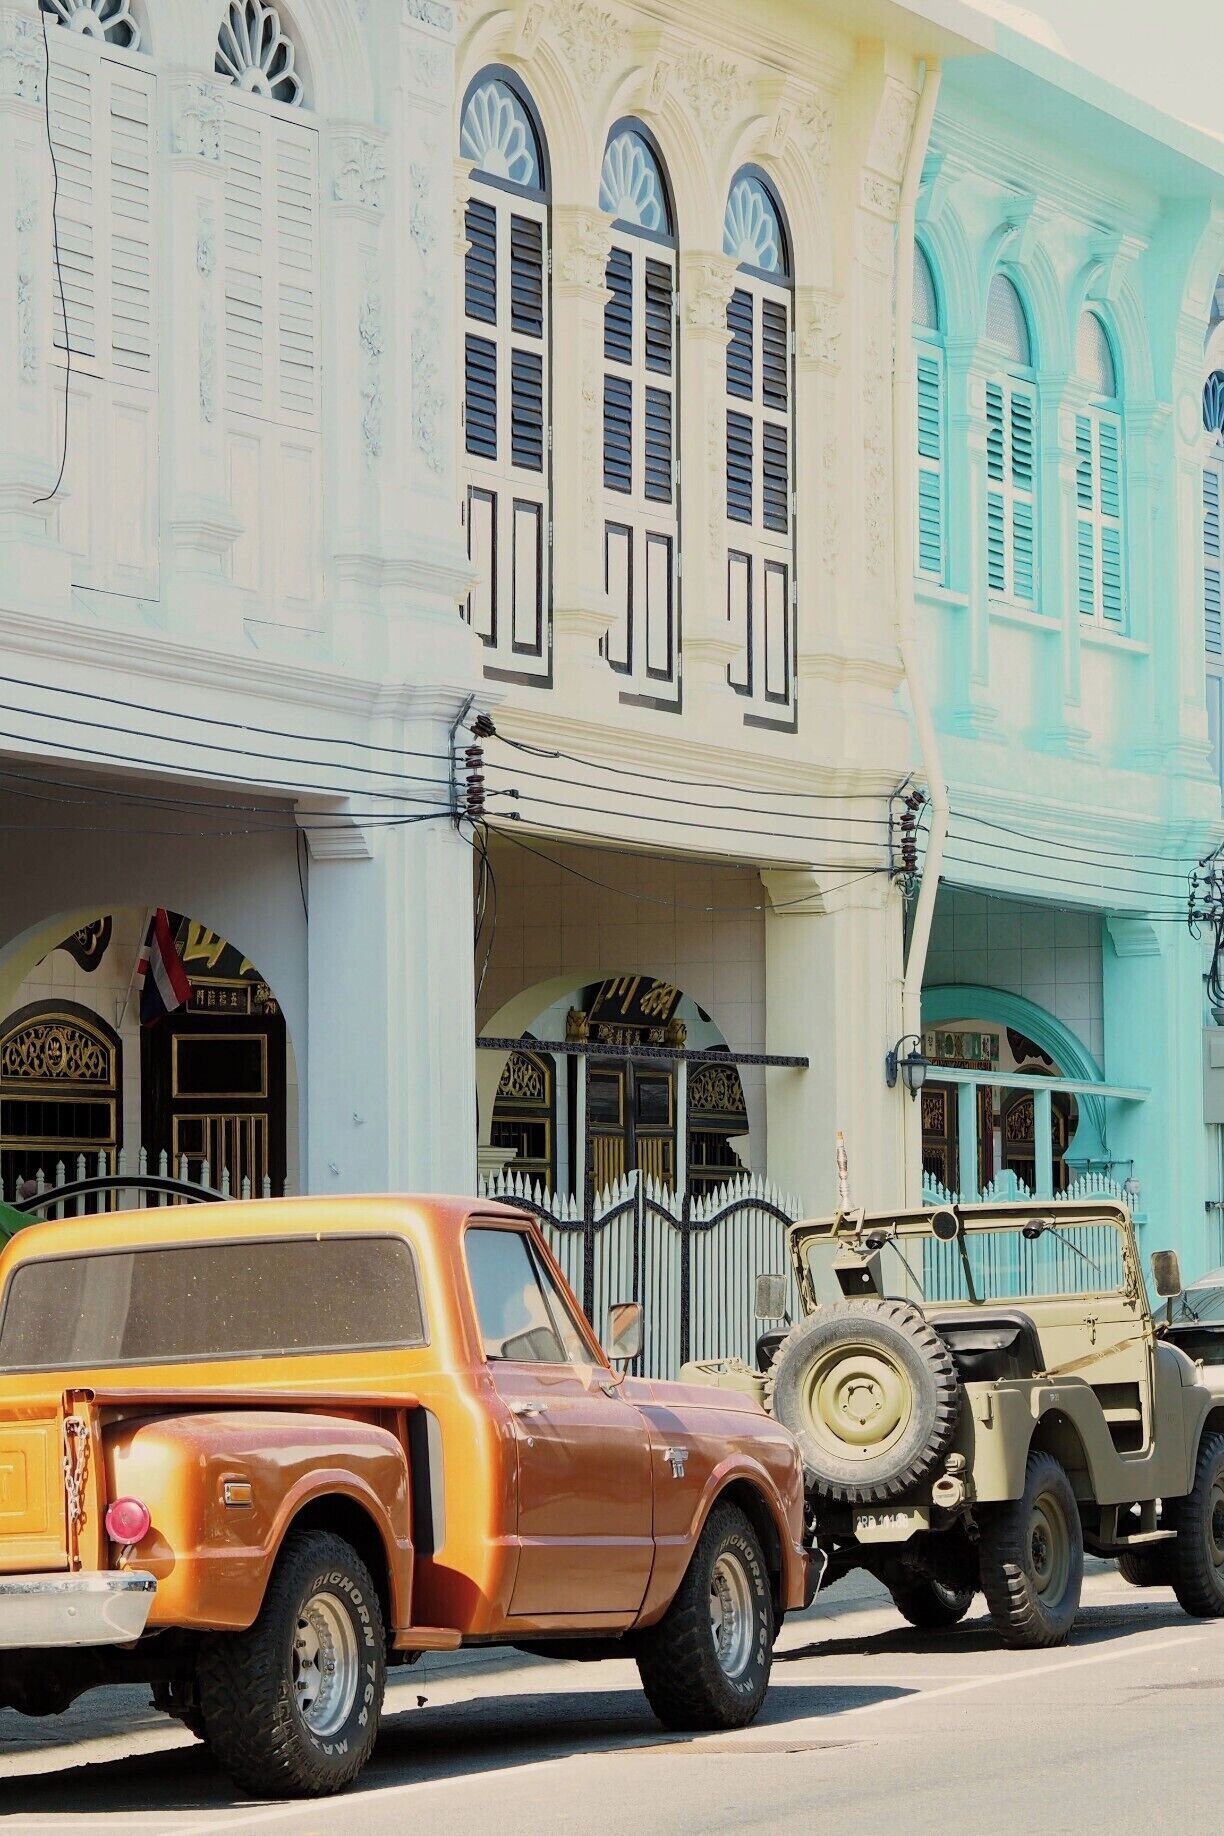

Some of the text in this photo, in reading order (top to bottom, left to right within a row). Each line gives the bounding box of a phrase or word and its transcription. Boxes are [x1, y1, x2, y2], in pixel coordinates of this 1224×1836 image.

[720, 1534, 765, 1596] BIGHORN
[312, 1571, 376, 1727] BIGHORN 764
